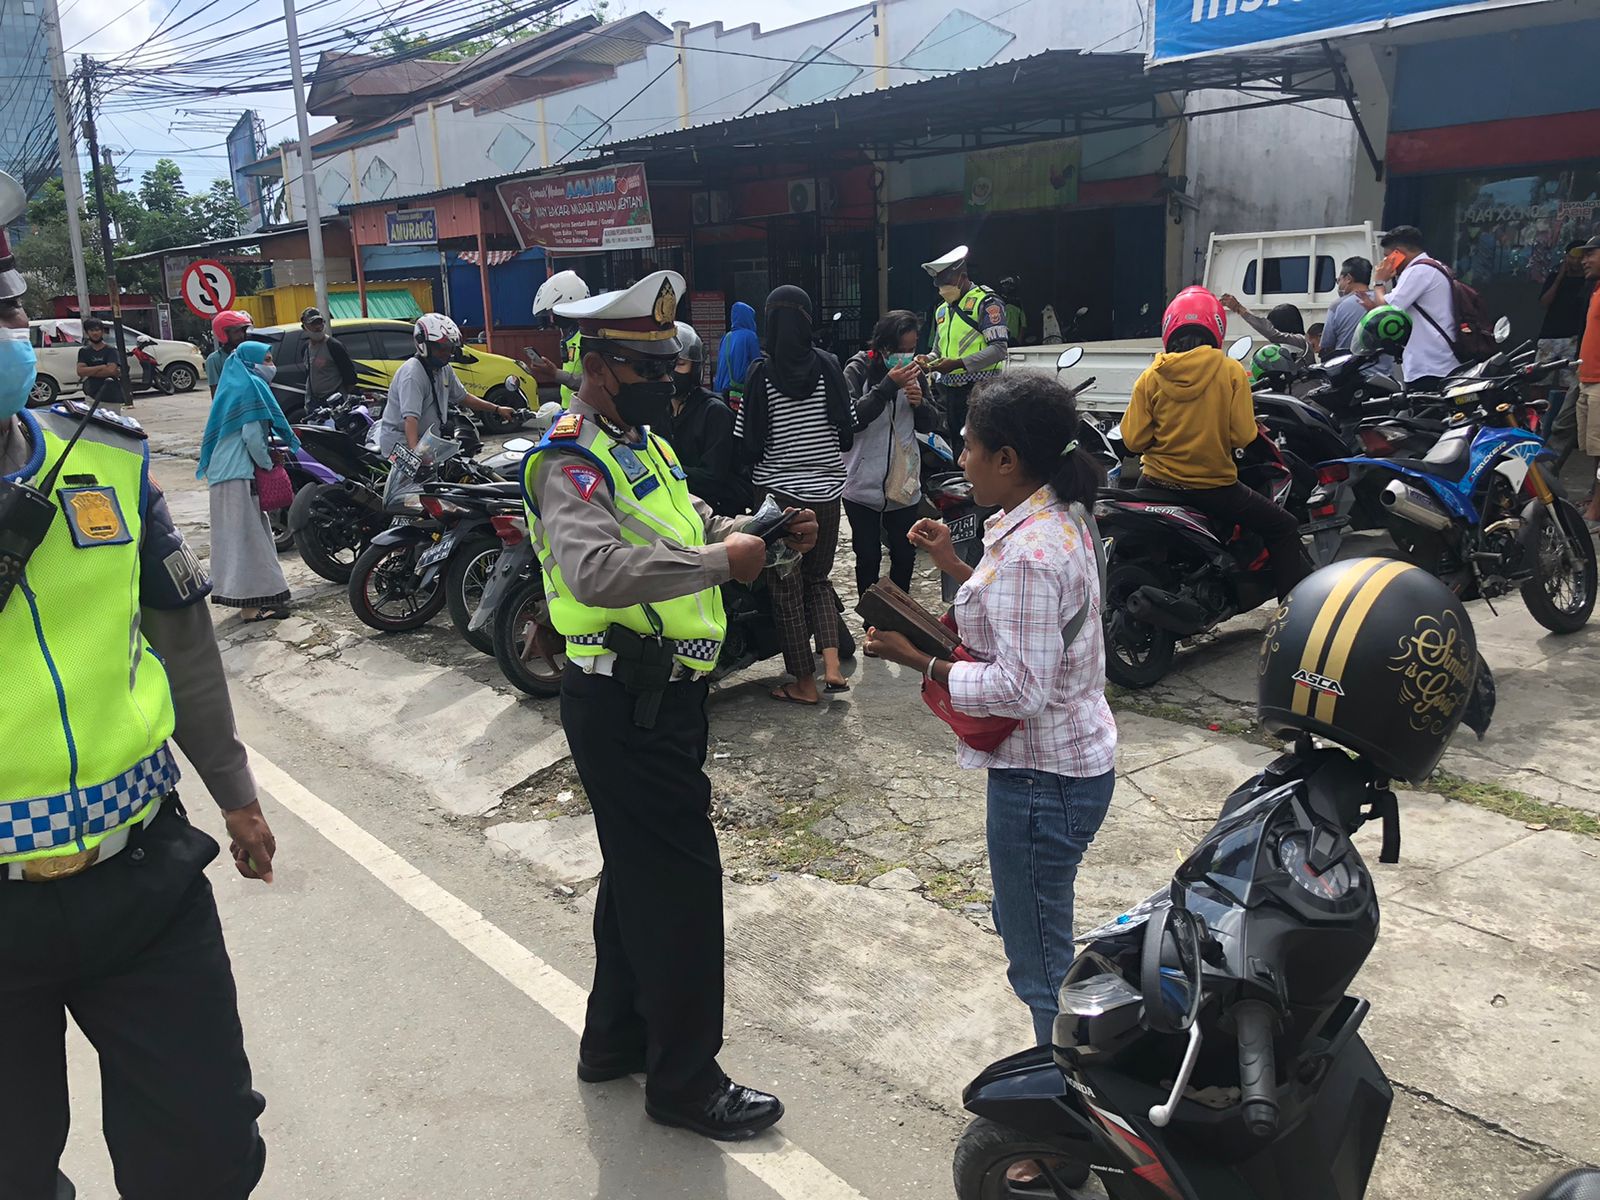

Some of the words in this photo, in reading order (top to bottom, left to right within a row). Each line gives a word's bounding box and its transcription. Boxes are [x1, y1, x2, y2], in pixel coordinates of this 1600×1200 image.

[391, 221, 434, 241] AMURANG
[199, 273, 219, 306] S
[1404, 661, 1420, 678] is
[1291, 668, 1346, 697] ASCA
